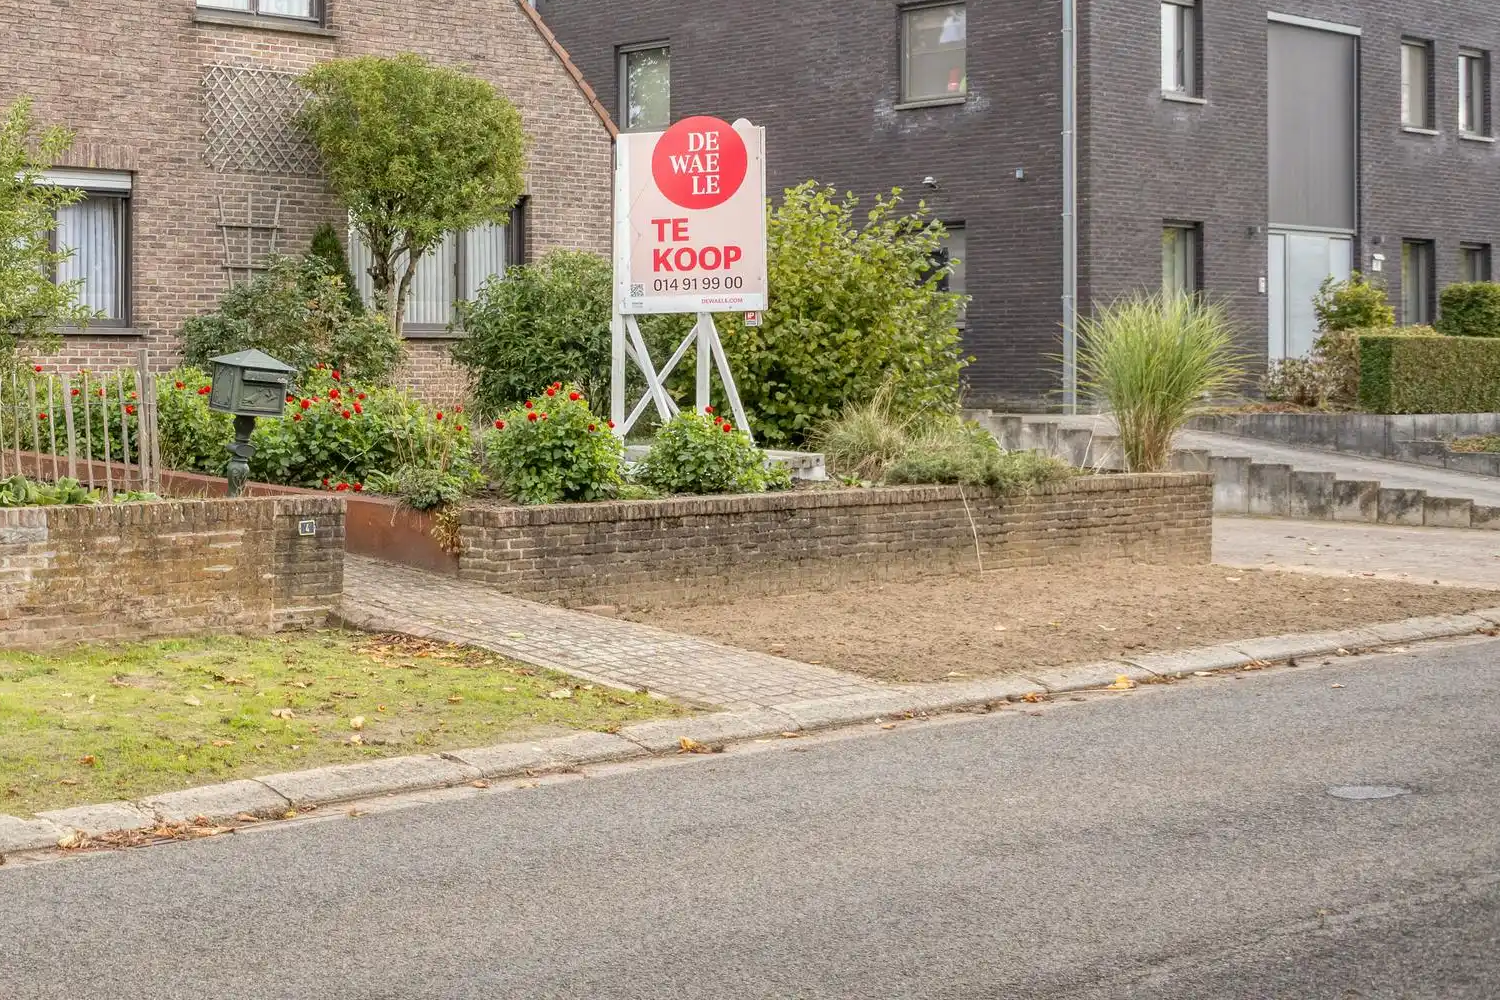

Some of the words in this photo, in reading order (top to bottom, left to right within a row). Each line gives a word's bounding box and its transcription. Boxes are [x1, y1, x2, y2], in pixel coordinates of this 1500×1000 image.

[688, 131, 719, 152] DE
[669, 153, 719, 174] WAE
[692, 175, 720, 195] LE
[651, 218, 689, 242] TE
[653, 246, 742, 272] KOOP
[653, 279, 678, 291] 014
[682, 278, 697, 290] 91
[702, 277, 720, 289] 99
[724, 276, 743, 289] 00
